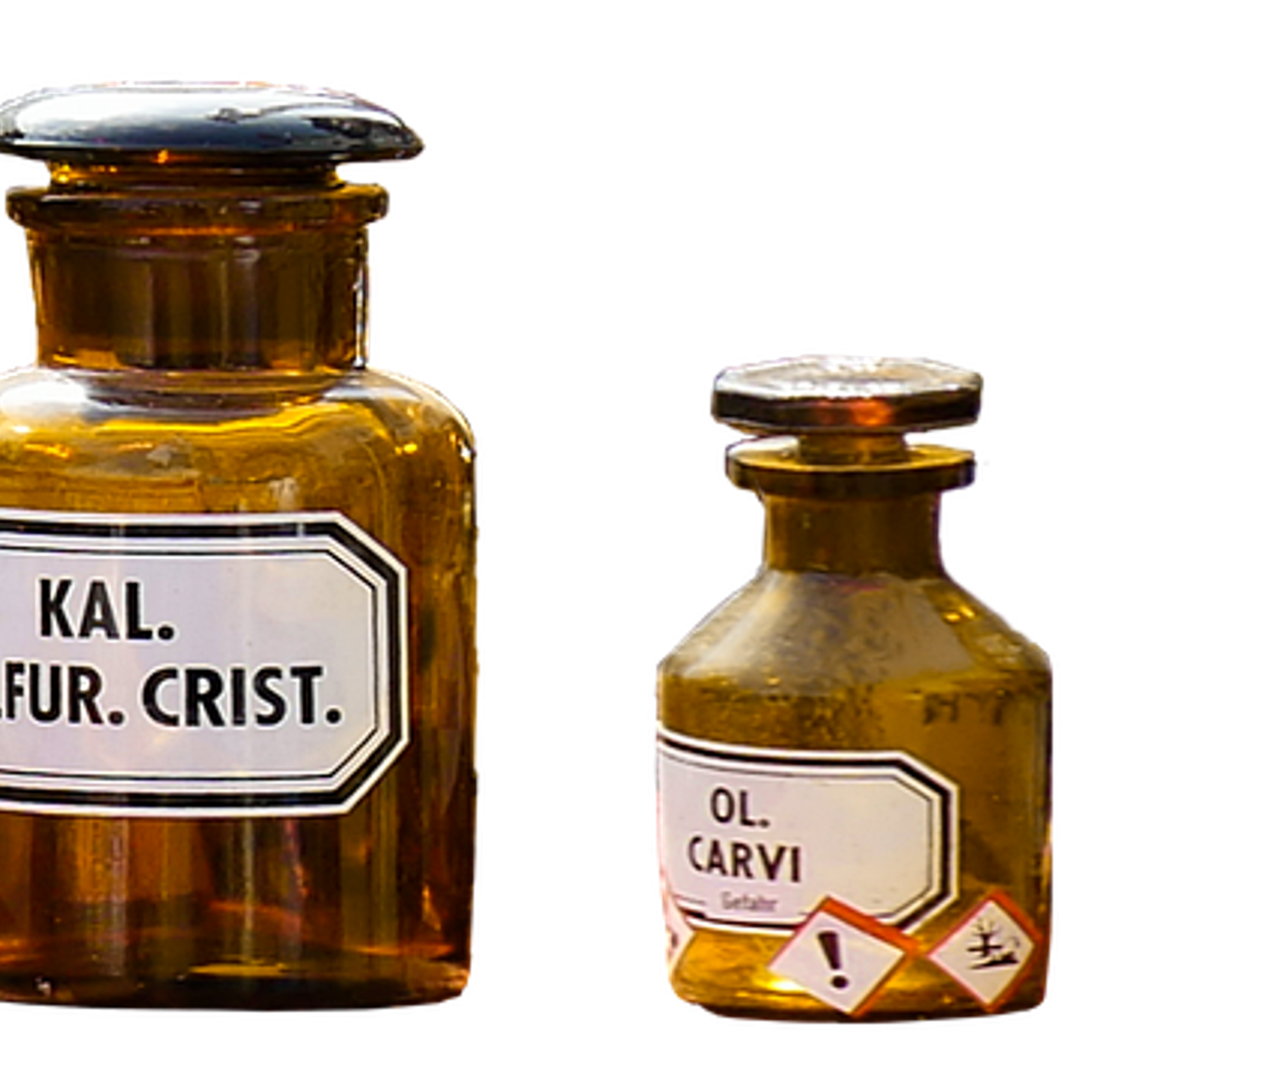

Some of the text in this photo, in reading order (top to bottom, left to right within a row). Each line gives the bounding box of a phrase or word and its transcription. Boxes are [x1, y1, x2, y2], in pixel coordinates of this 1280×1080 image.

[39, 578, 175, 641] KAL.
[142, 665, 342, 727] CRIST.
[710, 786, 771, 828] OL.
[688, 836, 802, 883] CARVI
